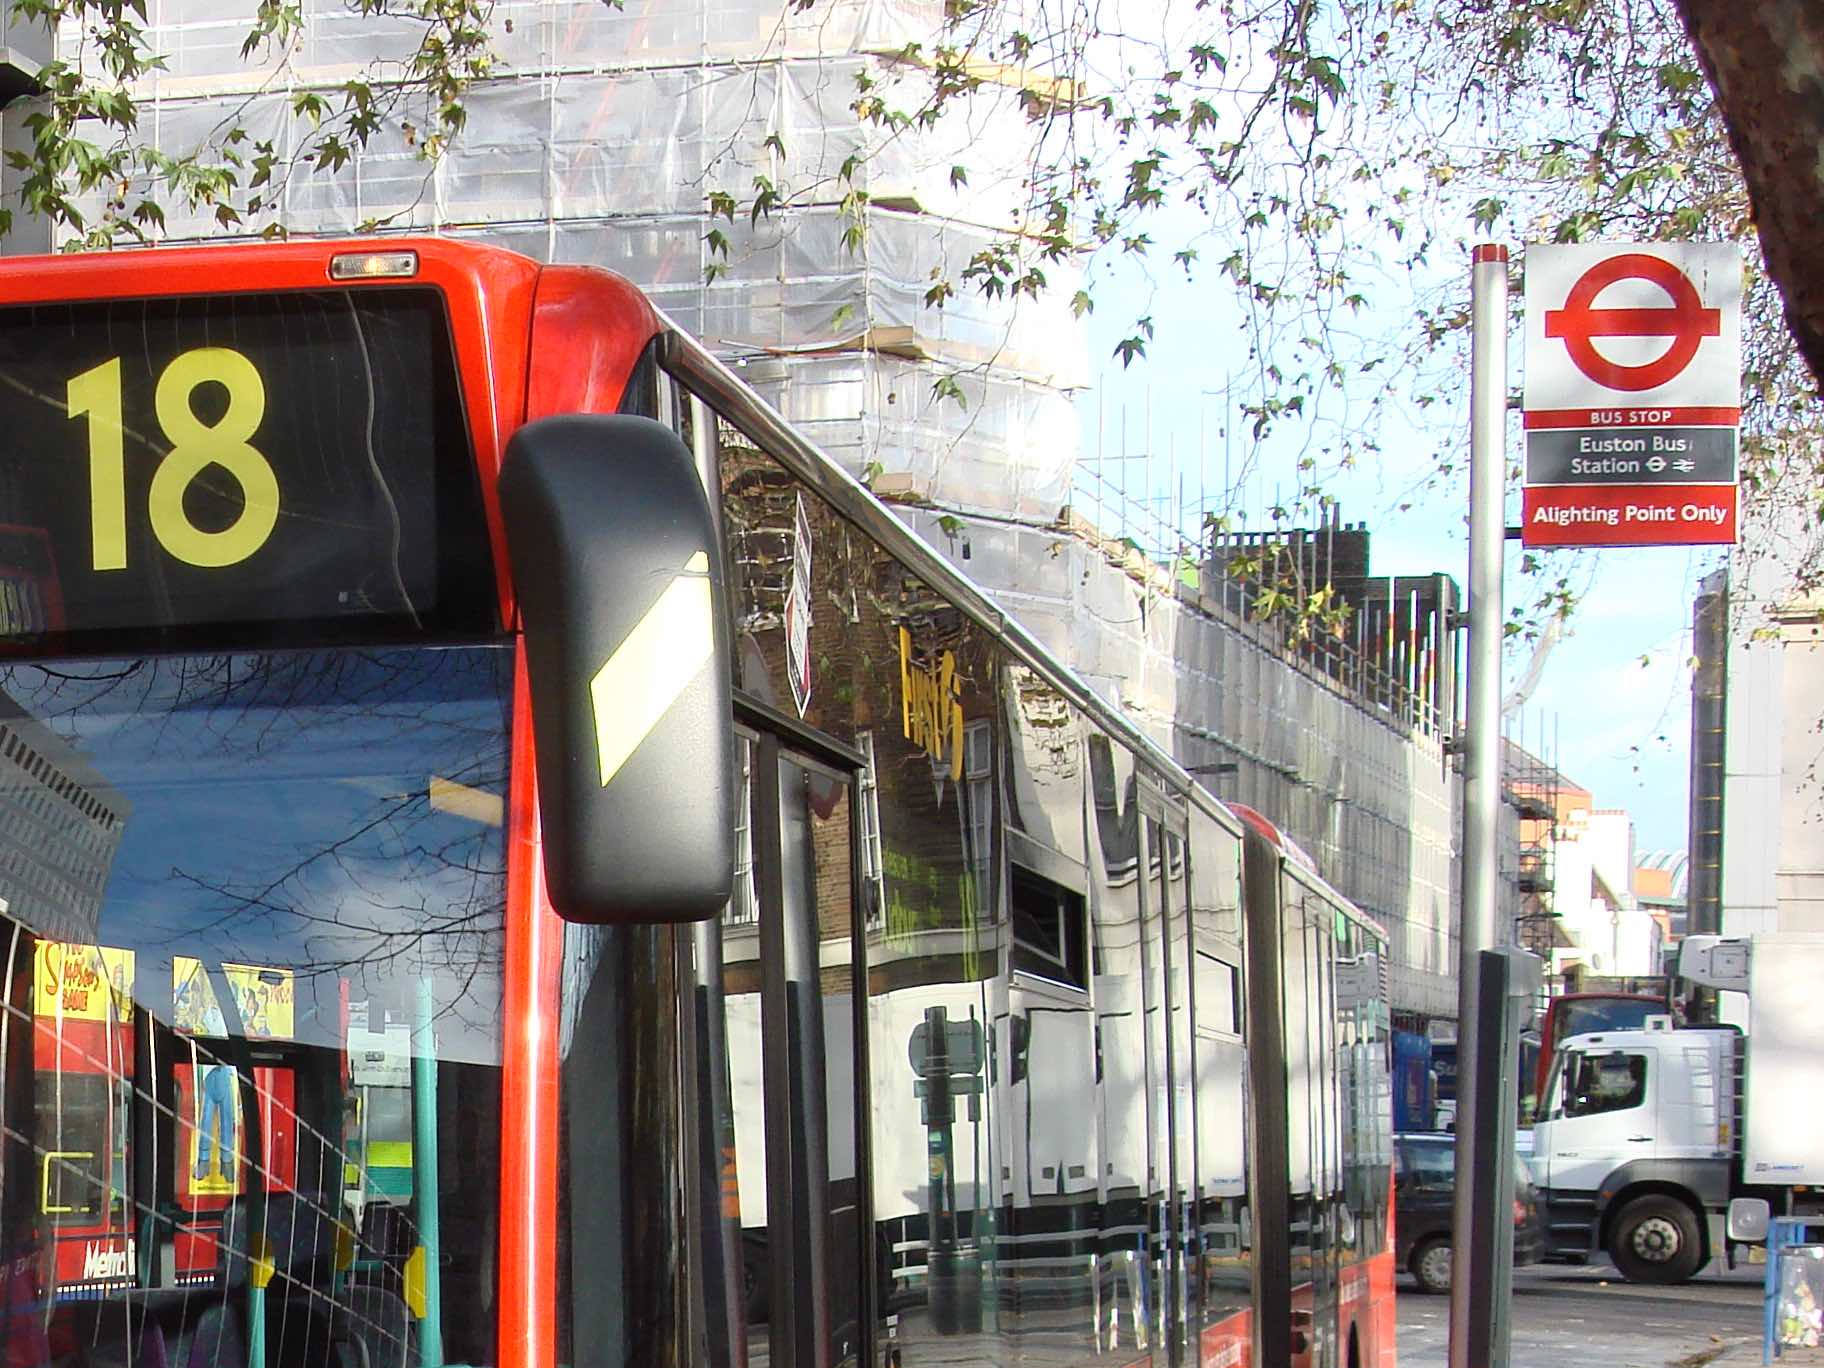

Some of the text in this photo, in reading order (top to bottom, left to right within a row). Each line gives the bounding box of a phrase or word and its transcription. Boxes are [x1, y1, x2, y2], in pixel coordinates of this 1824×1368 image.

[1590, 410, 1672, 425] BUS STOP
[1580, 435, 1687, 453] Euston Bus
[66, 346, 280, 571] 18
[1571, 457, 1640, 475] Station
[1532, 503, 1728, 526] Alighting Point Only
